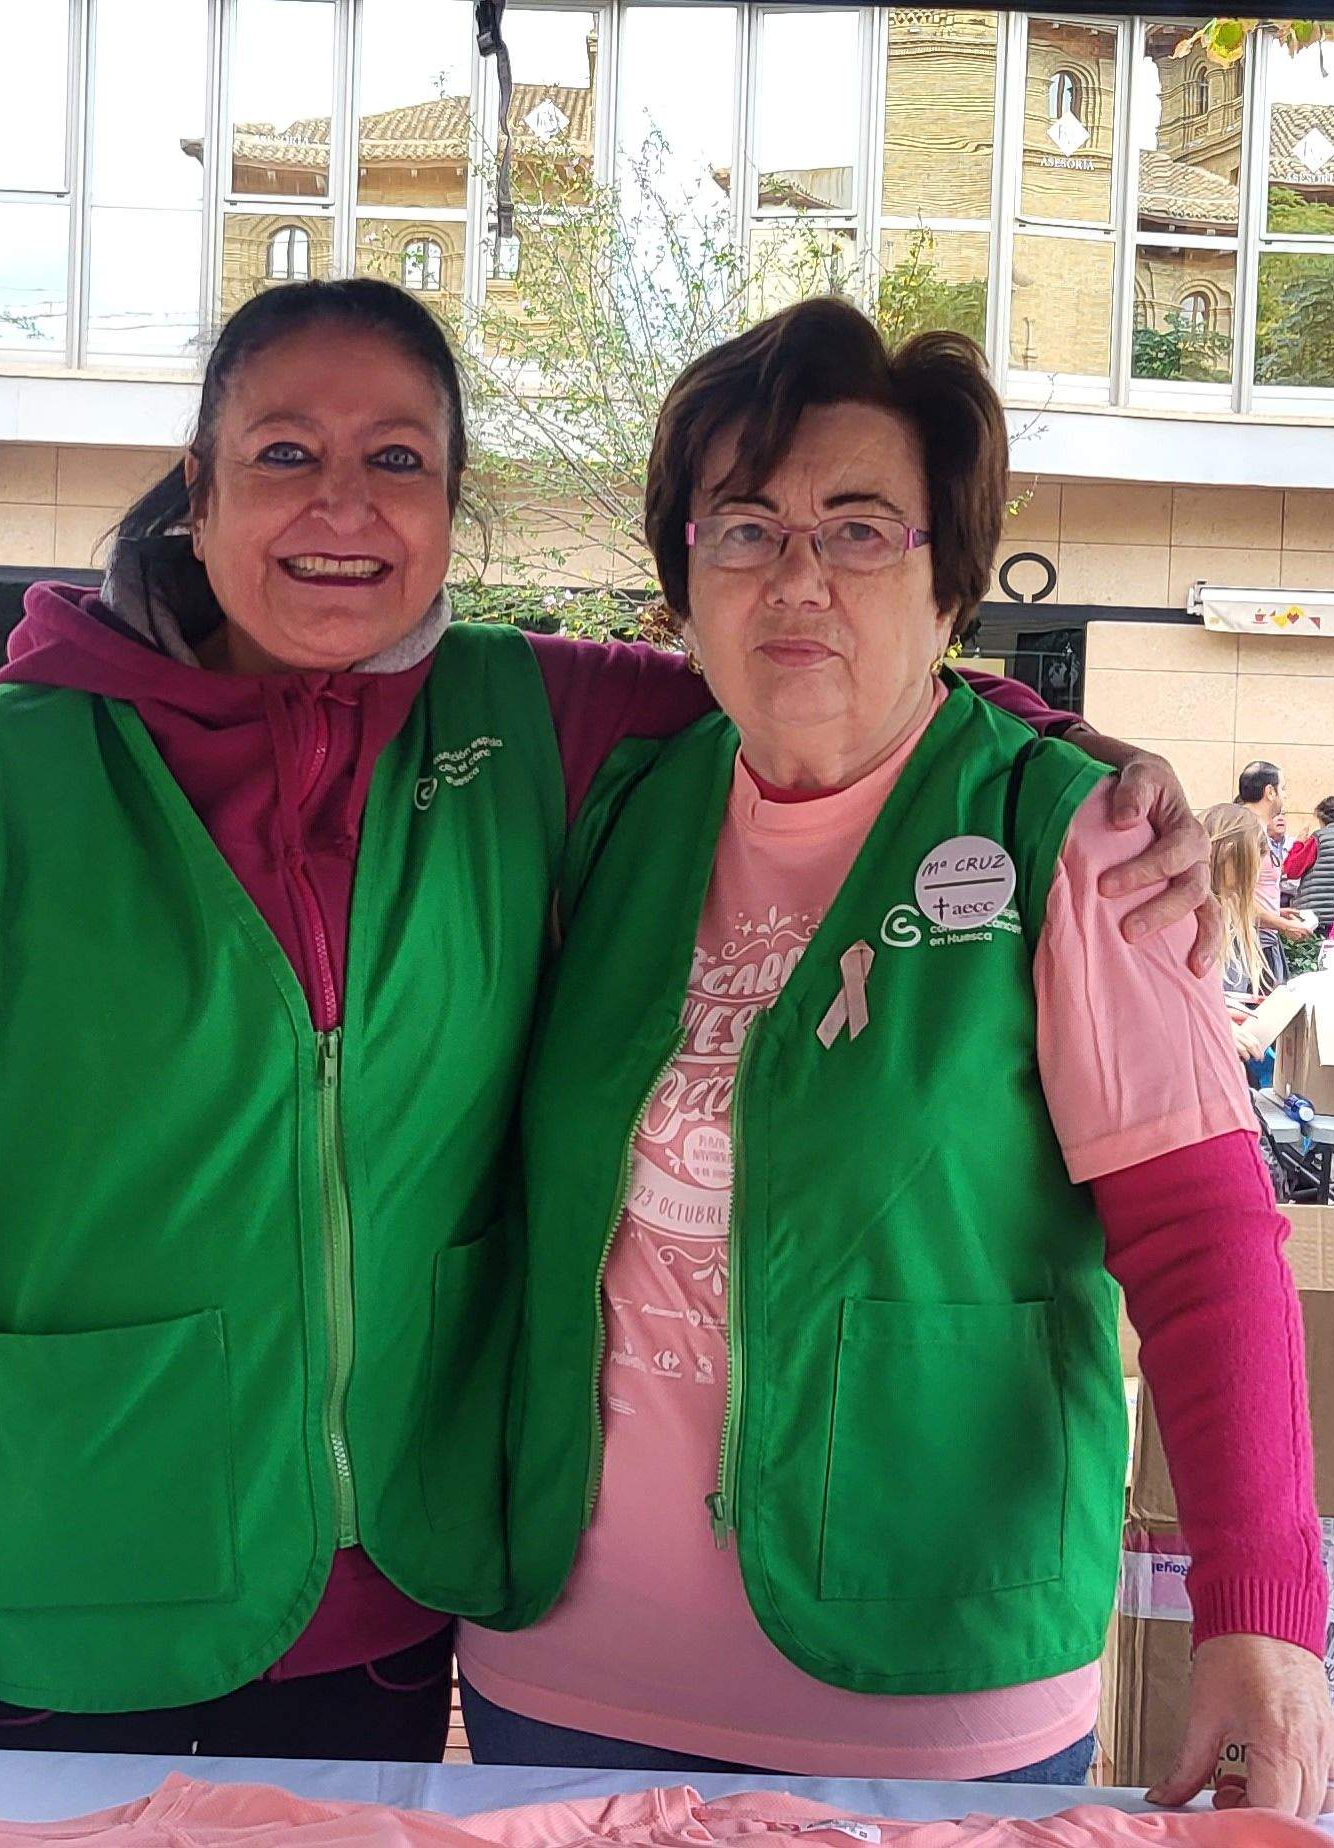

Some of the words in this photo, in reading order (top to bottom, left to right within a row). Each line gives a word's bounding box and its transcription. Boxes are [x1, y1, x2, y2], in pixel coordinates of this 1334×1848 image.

[954, 854, 1006, 873] CRUZ
[952, 901, 995, 915] aecc
[635, 1185, 653, 1206] 23
[1152, 1561, 1189, 1577] Royal
